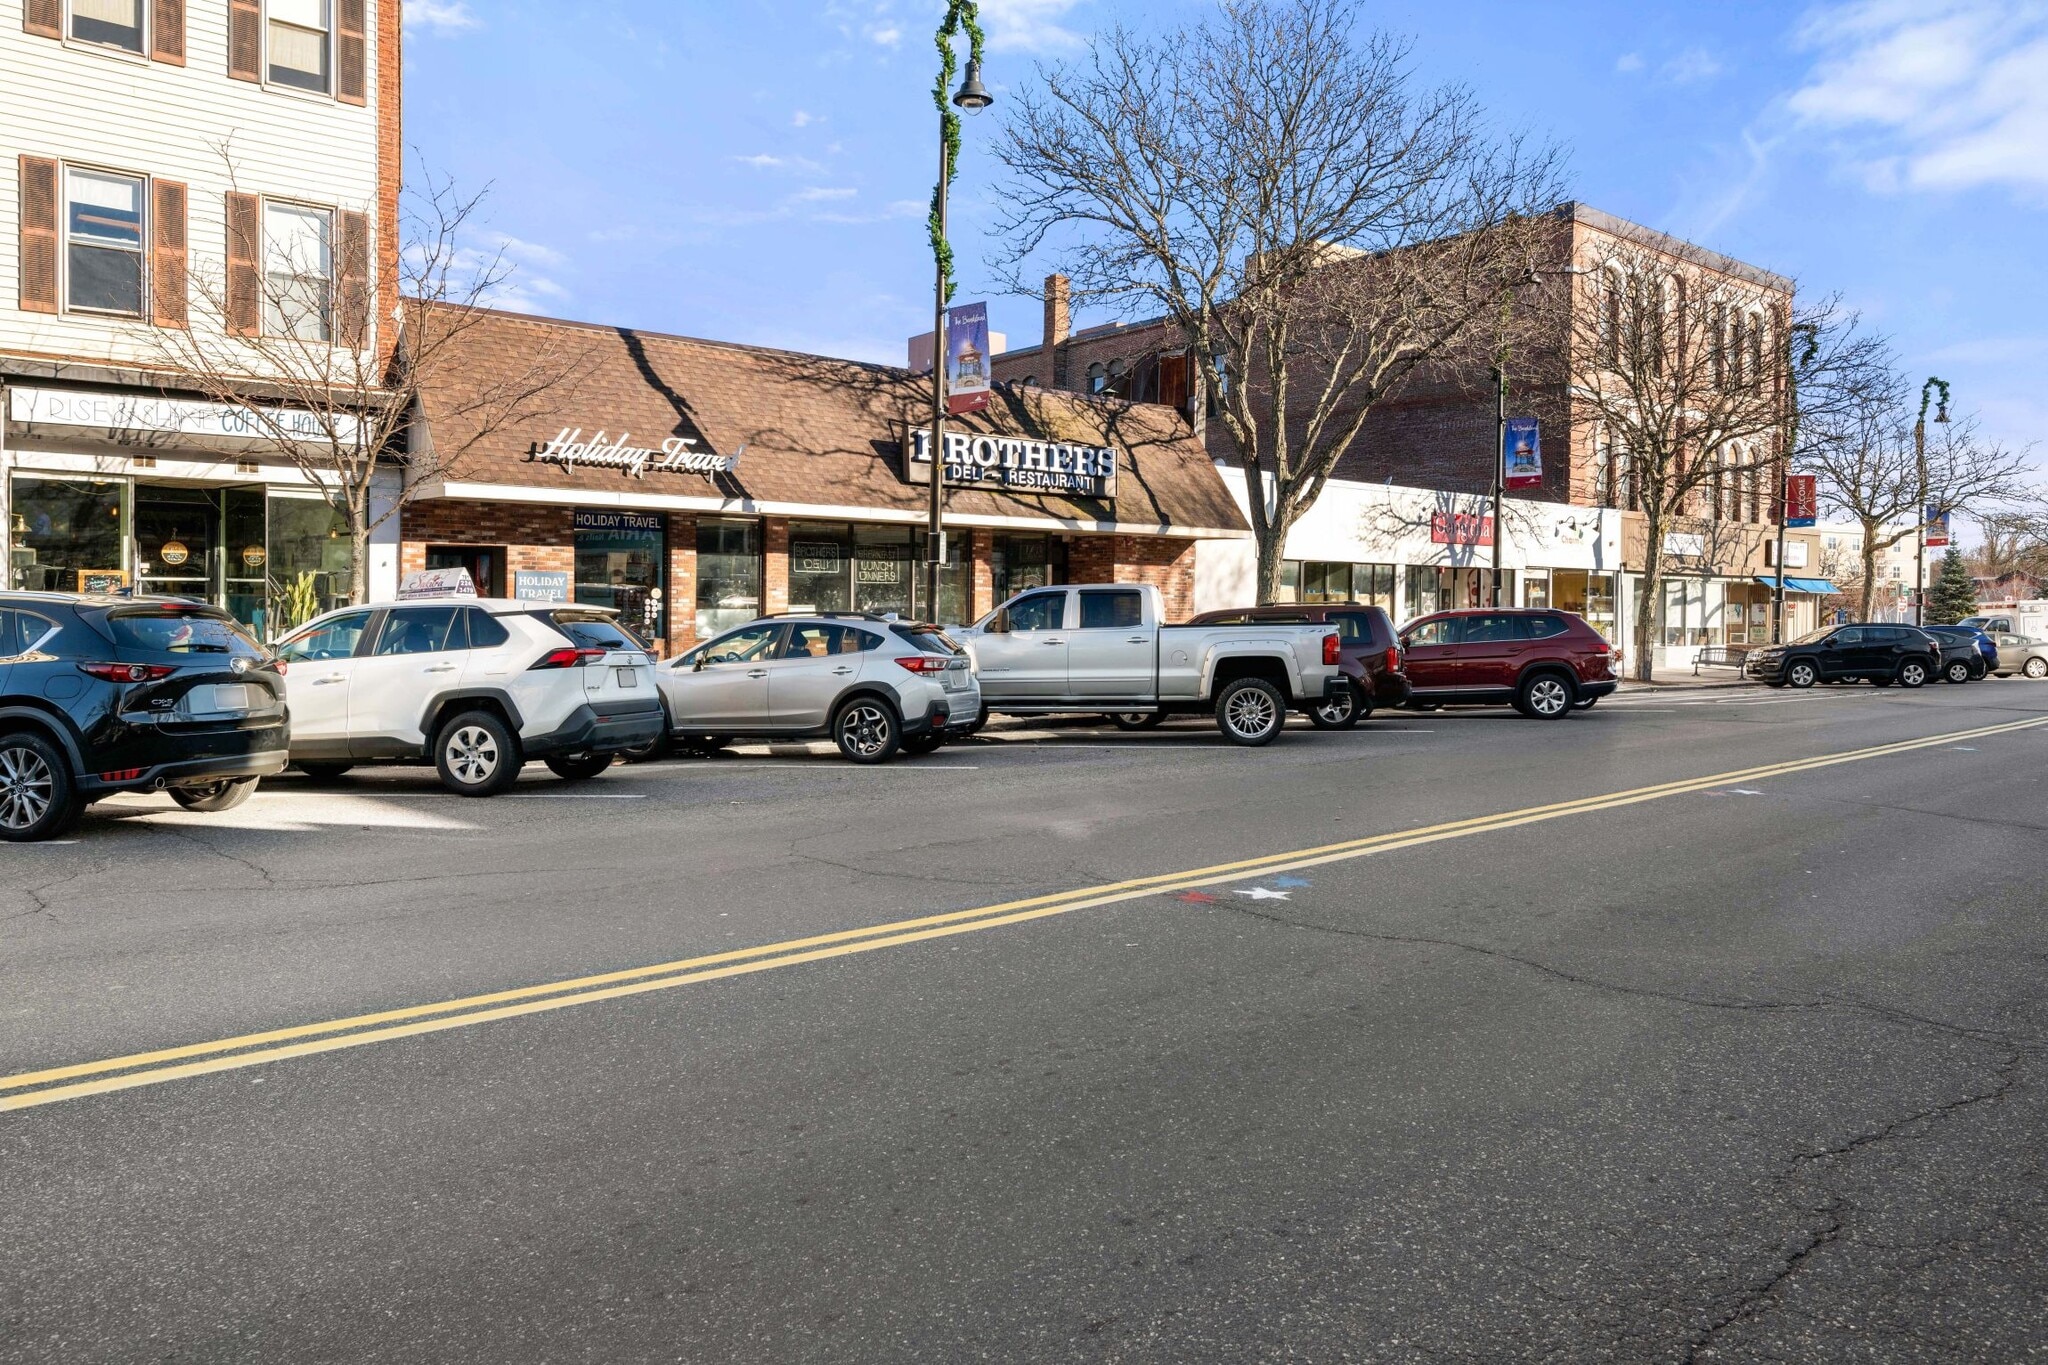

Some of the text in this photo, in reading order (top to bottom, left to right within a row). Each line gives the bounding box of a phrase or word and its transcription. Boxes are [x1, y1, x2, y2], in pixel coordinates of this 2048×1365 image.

[50, 397, 108, 423] RISE
[113, 402, 134, 424] &
[221, 408, 286, 436] COFFEE
[536, 427, 744, 475] Holiday Travel
[952, 465, 985, 481] DELI
[1009, 469, 1092, 490] RESTAURANT
[576, 513, 661, 529] HOLIDAY TRAVEL
[519, 576, 565, 587] HOLIDAY
[520, 588, 564, 599] TRAVEL
